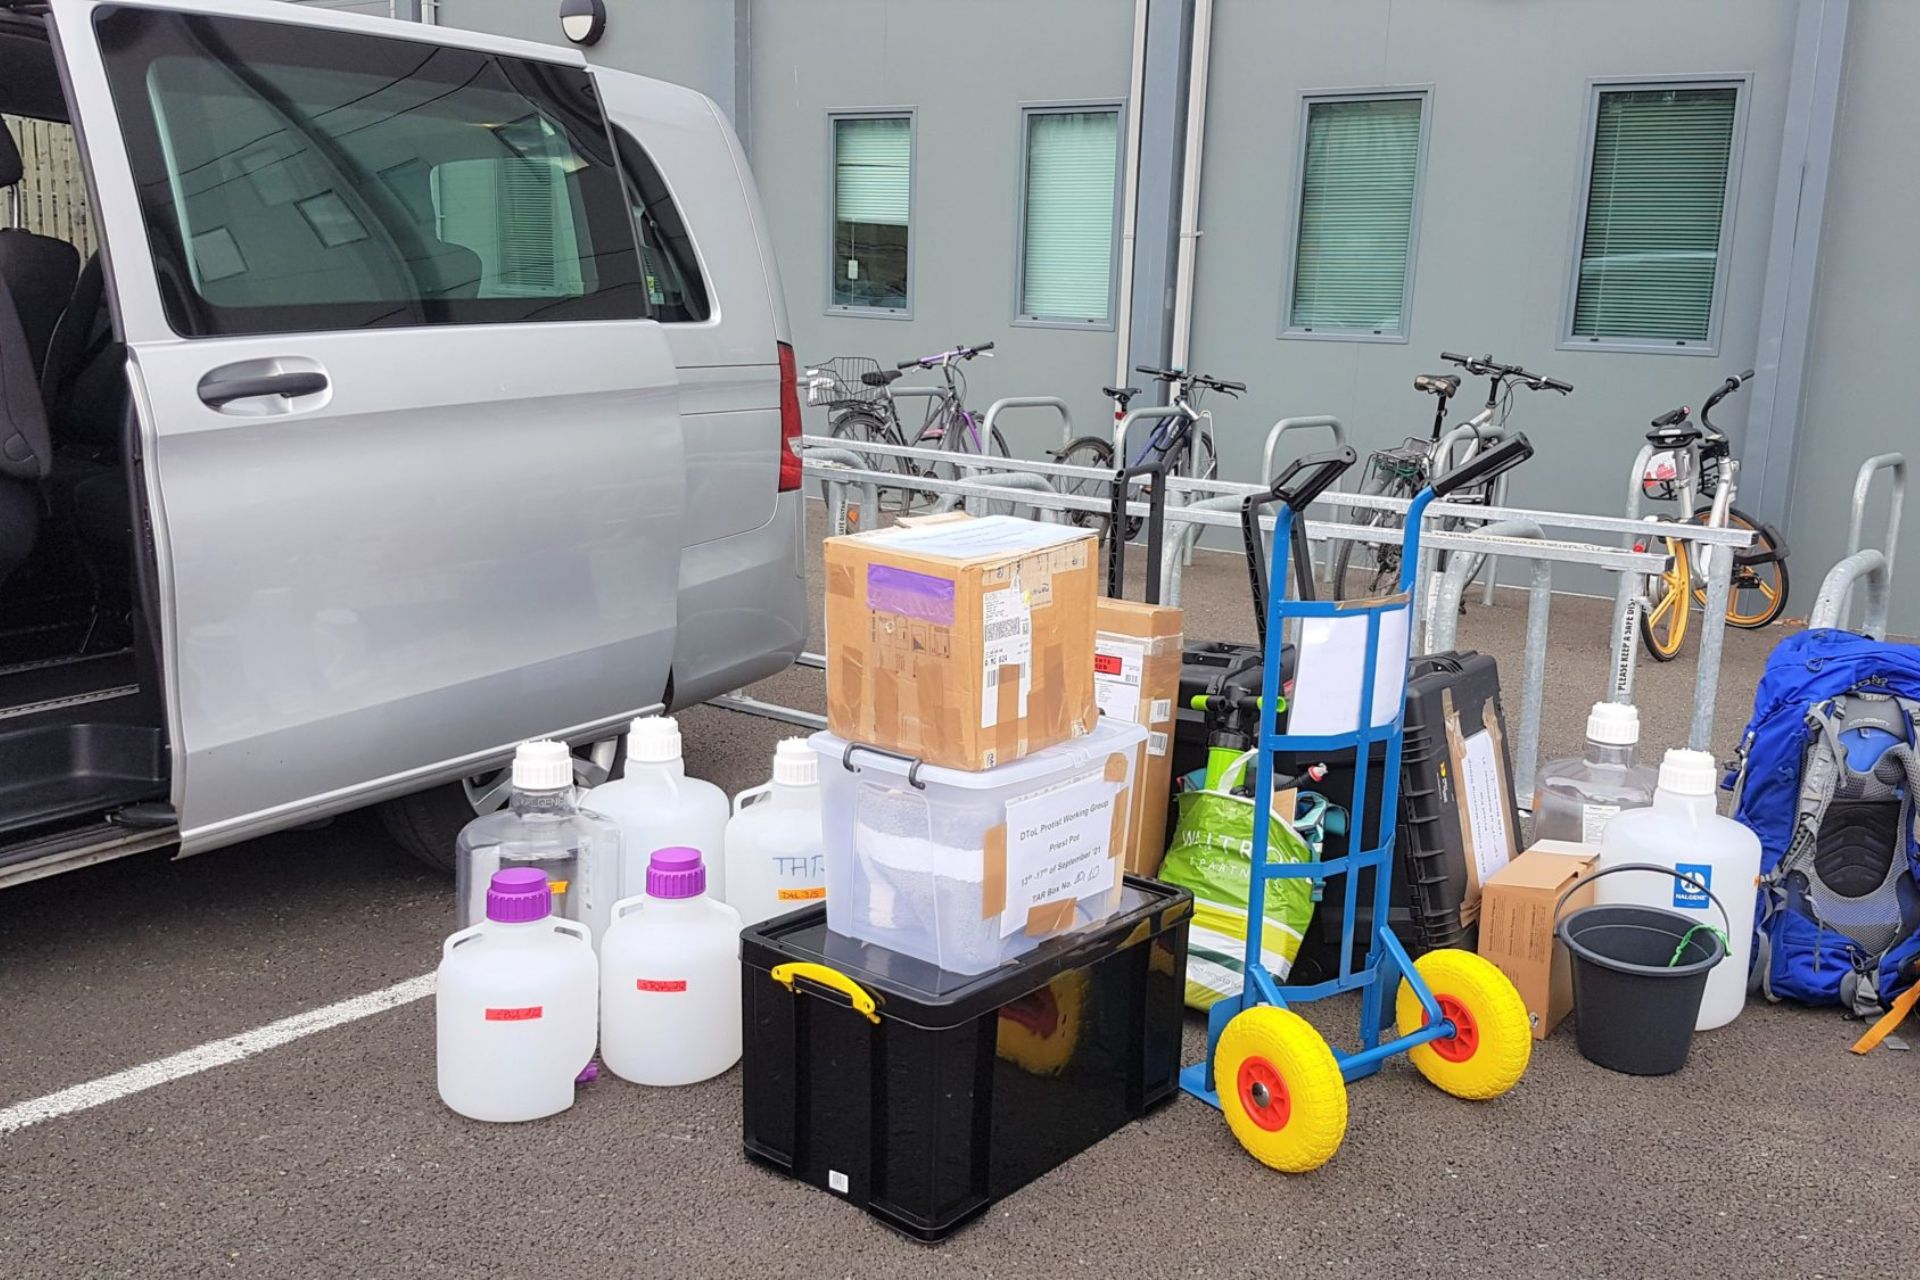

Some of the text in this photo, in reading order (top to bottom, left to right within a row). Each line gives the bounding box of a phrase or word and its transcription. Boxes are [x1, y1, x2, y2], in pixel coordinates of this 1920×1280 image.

[1627, 599, 1636, 615] DIS
[1625, 616, 1634, 634] SAFE
[1621, 643, 1630, 662] KEEP
[1617, 663, 1628, 690] PLEASE
[1040, 818, 1062, 832] Protist
[1063, 809, 1089, 823] Working
[1090, 801, 1108, 812] Group
[1049, 833, 1080, 852] Priest Pot
[1057, 851, 1091, 870] September
[1032, 891, 1047, 903] TAR
[1047, 885, 1060, 897] Box
